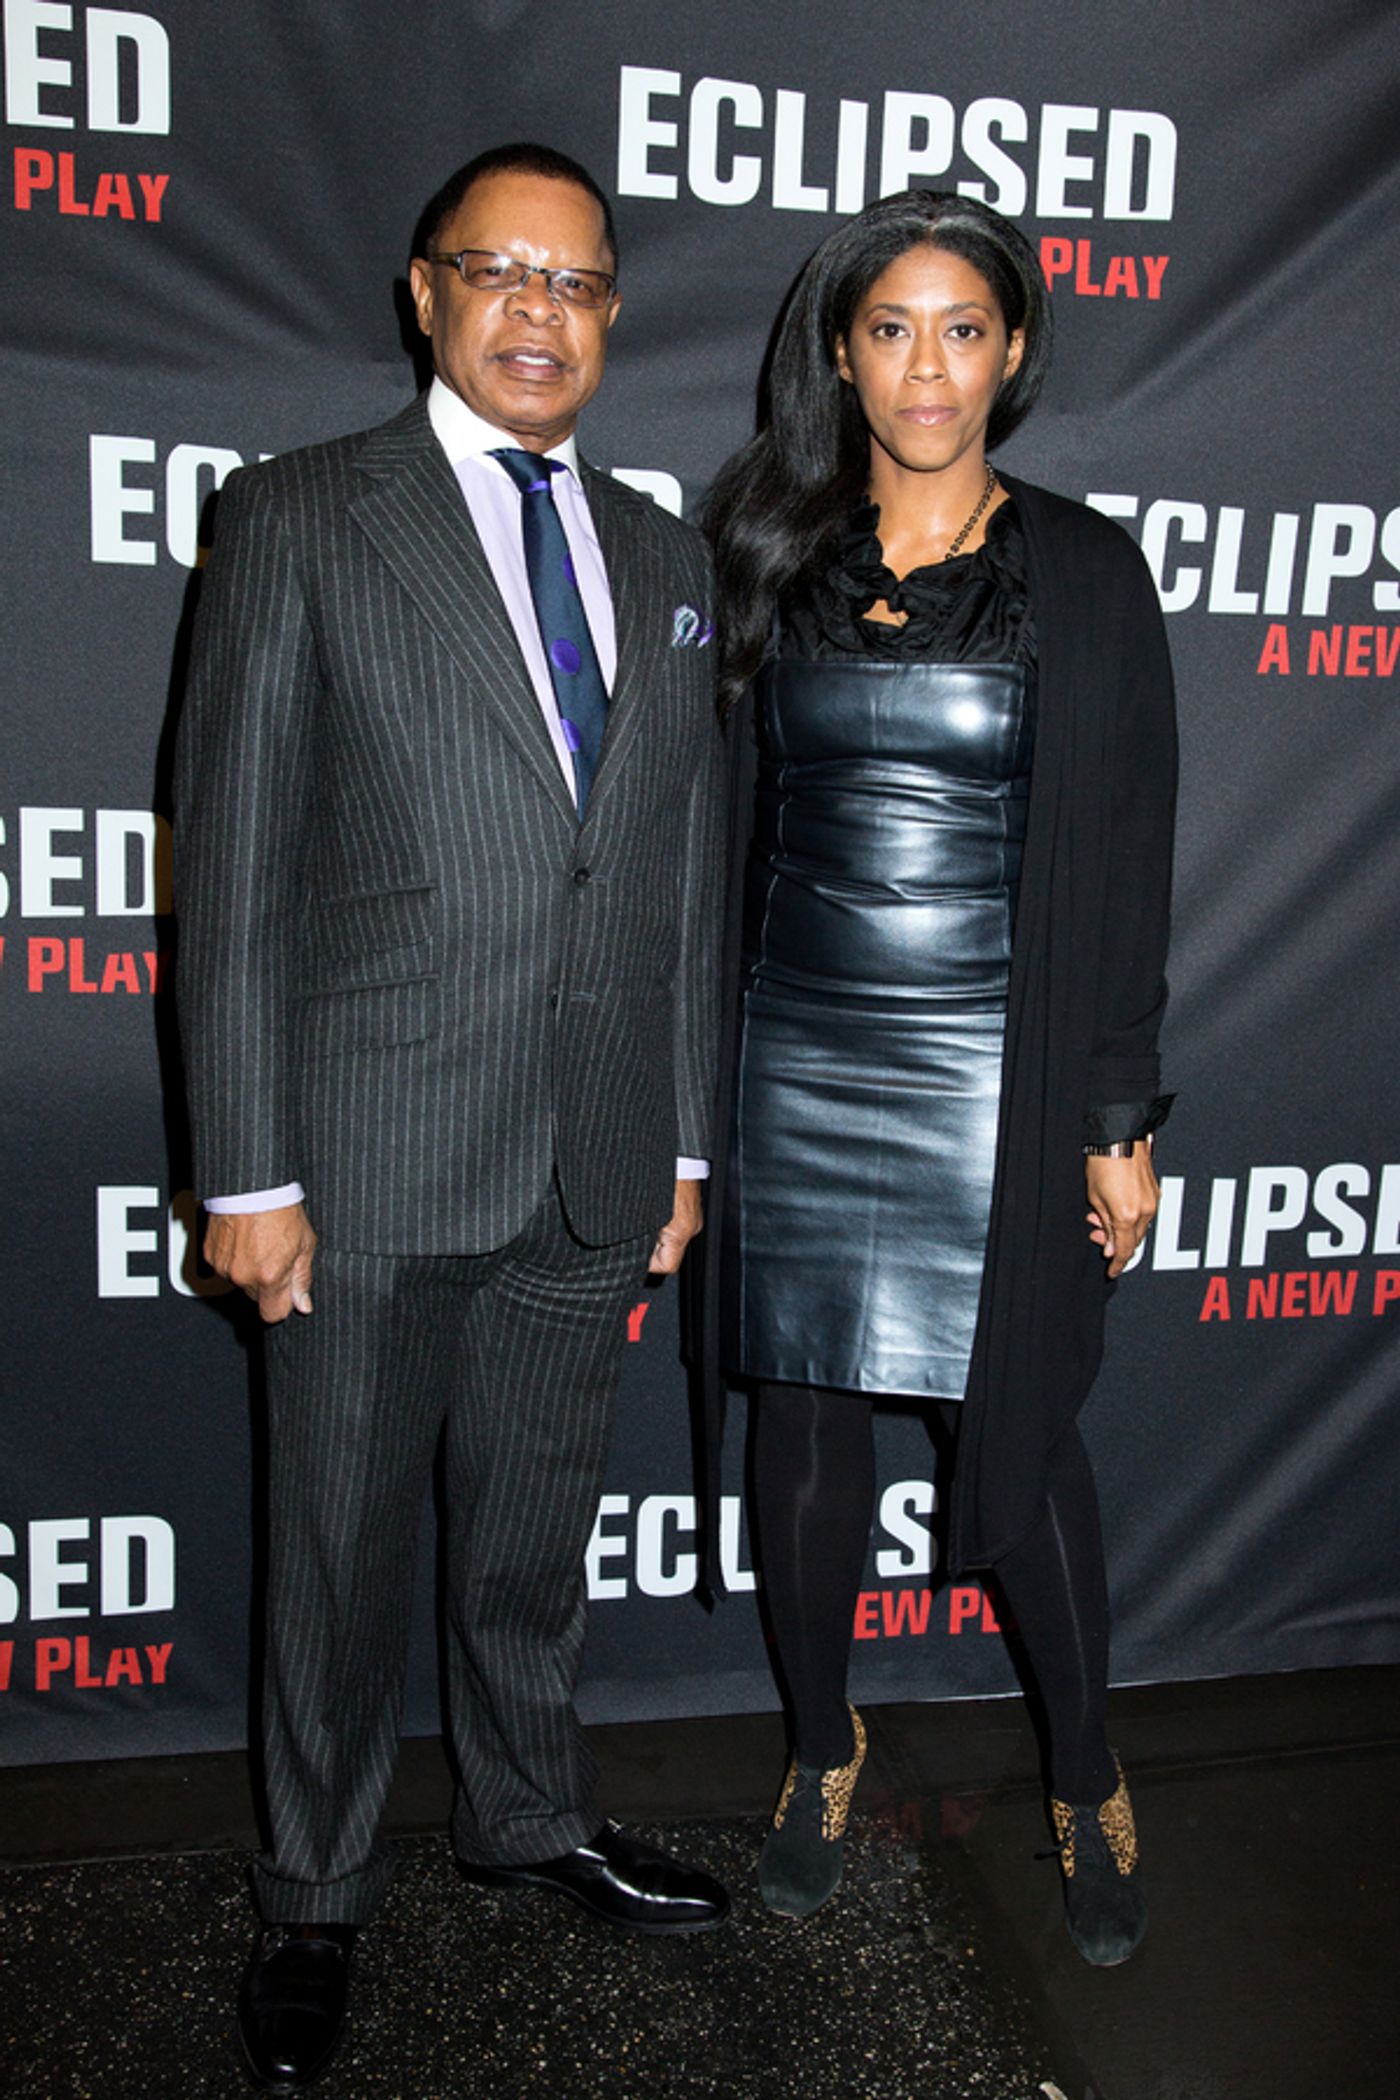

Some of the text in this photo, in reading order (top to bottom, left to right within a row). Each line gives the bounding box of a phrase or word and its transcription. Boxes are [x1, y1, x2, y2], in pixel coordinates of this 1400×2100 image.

[617, 65, 1177, 221] ECLIPSED
[14, 147, 170, 223] PLAY
[1040, 236, 1170, 300] PLAY
[1256, 624, 1291, 676] A
[0, 806, 173, 918] ED
[1200, 1276, 1231, 1322] A
[1246, 1270, 1359, 1320] NEW
[35, 1635, 174, 1691] PLAY
